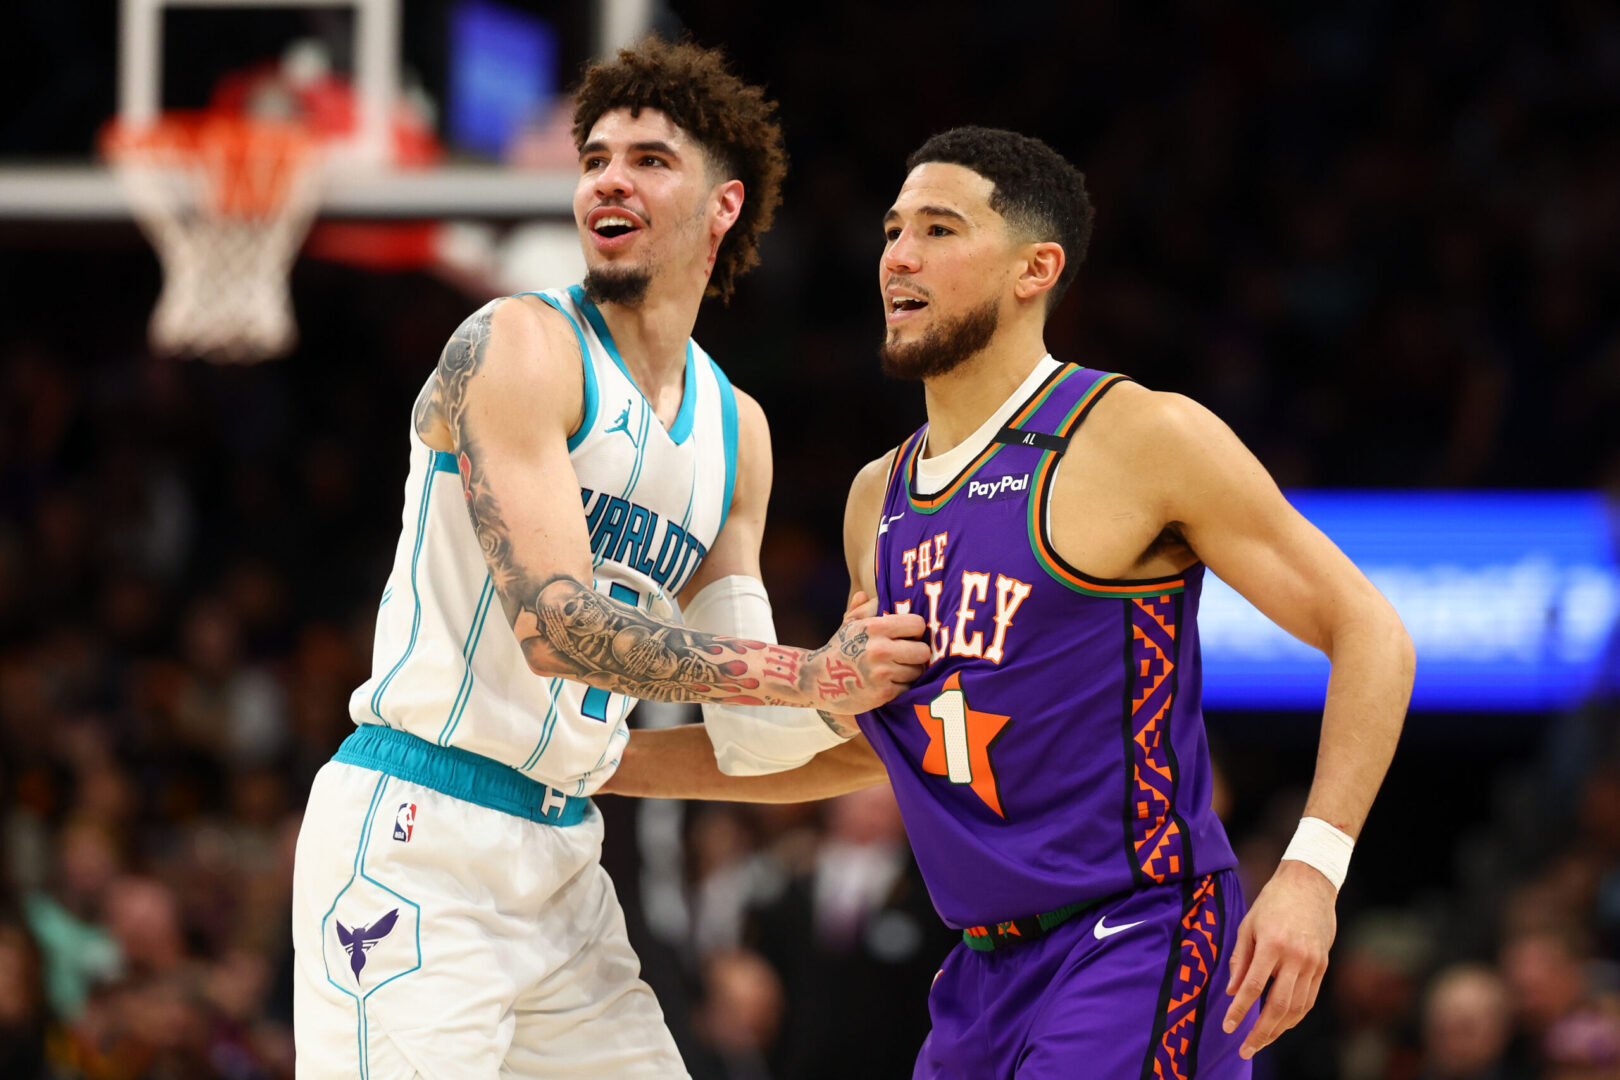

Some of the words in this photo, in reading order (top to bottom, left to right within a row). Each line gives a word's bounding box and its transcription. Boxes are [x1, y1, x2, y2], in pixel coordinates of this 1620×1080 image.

[1022, 432, 1035, 445] AL
[968, 474, 1030, 499] PayPal
[902, 531, 948, 588] THE
[929, 688, 973, 785] 1
